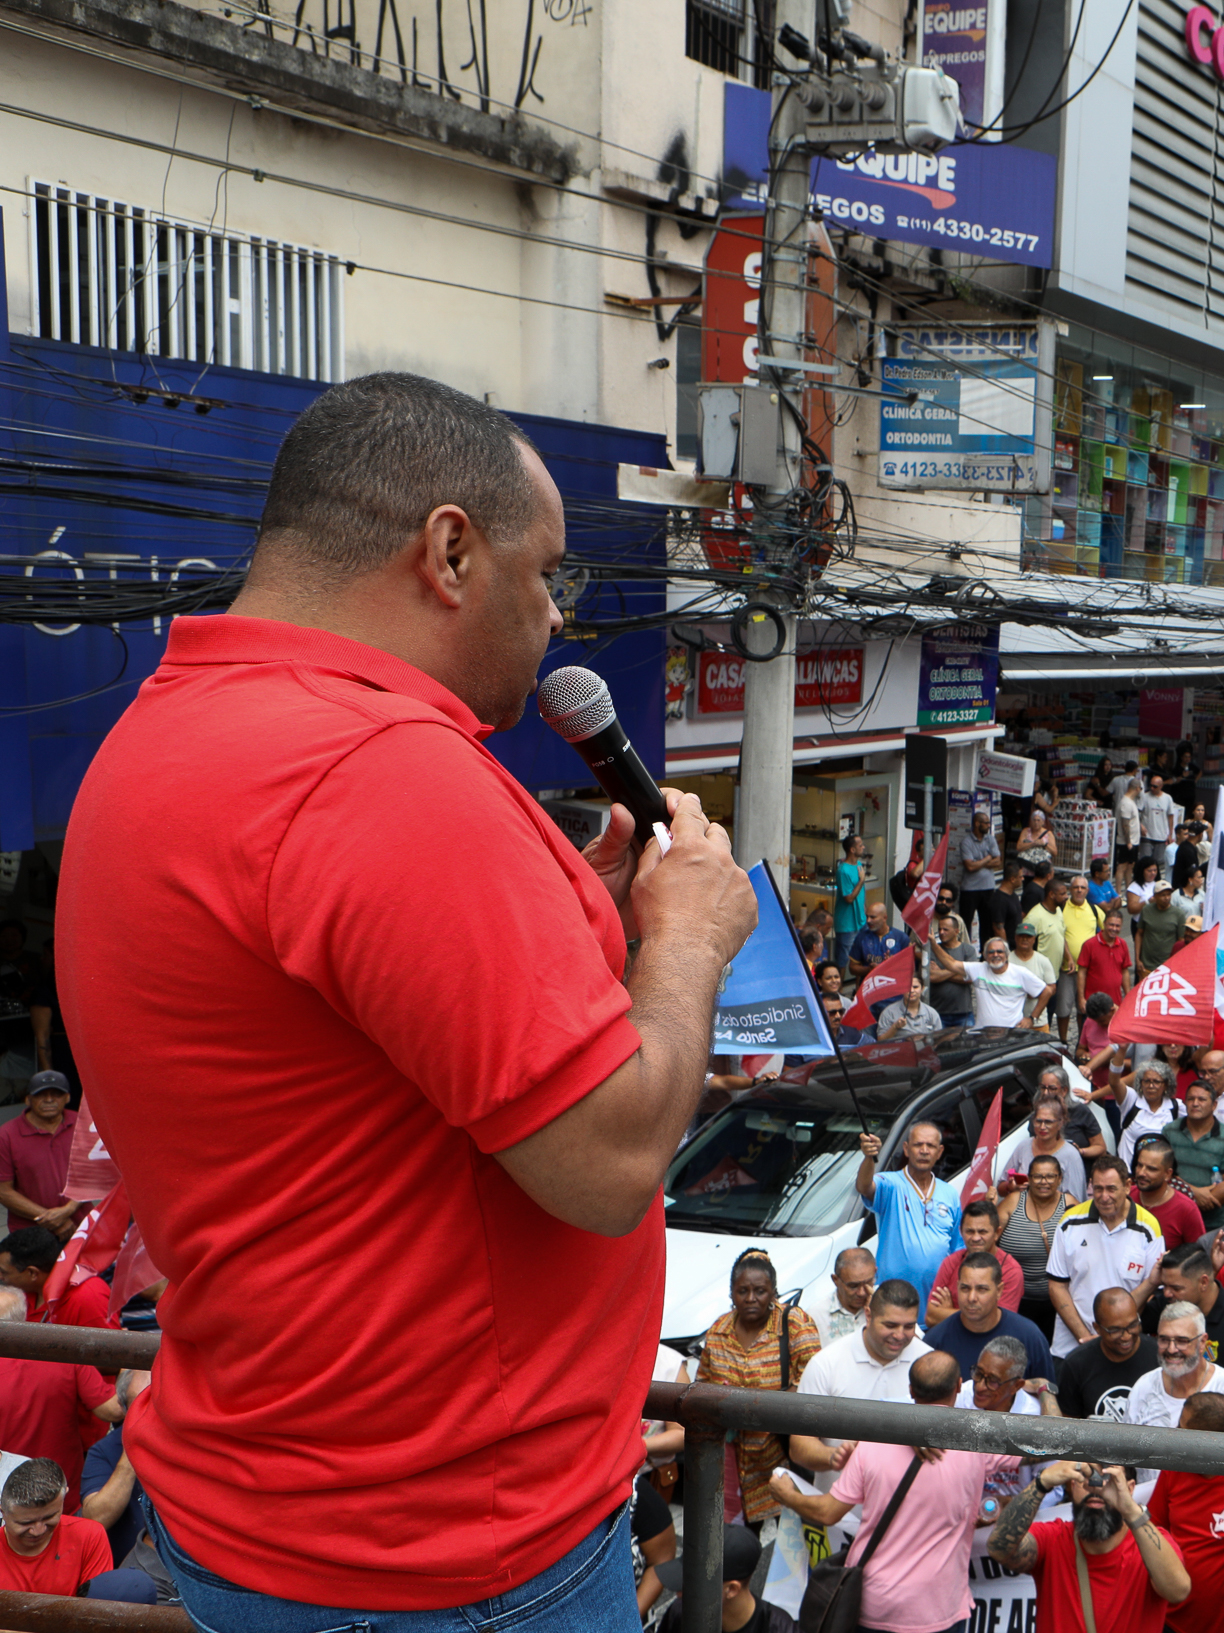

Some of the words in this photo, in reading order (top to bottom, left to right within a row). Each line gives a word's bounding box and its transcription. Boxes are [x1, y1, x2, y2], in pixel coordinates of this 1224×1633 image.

[924, 7, 986, 34] EQUIPE
[923, 50, 986, 68] EMPREGOS
[933, 217, 1039, 252] 4330-2577
[883, 404, 922, 420] CLÍNICA
[924, 406, 957, 420] GERAL
[886, 431, 952, 445] ORTODONTIA
[930, 666, 960, 683] CLÍNICA
[961, 668, 984, 682] GERAL
[929, 685, 982, 701] ORTODONTIA
[1146, 689, 1181, 702] VONNY
[936, 709, 979, 722] 4123-3327
[1128, 1261, 1144, 1274] PT
